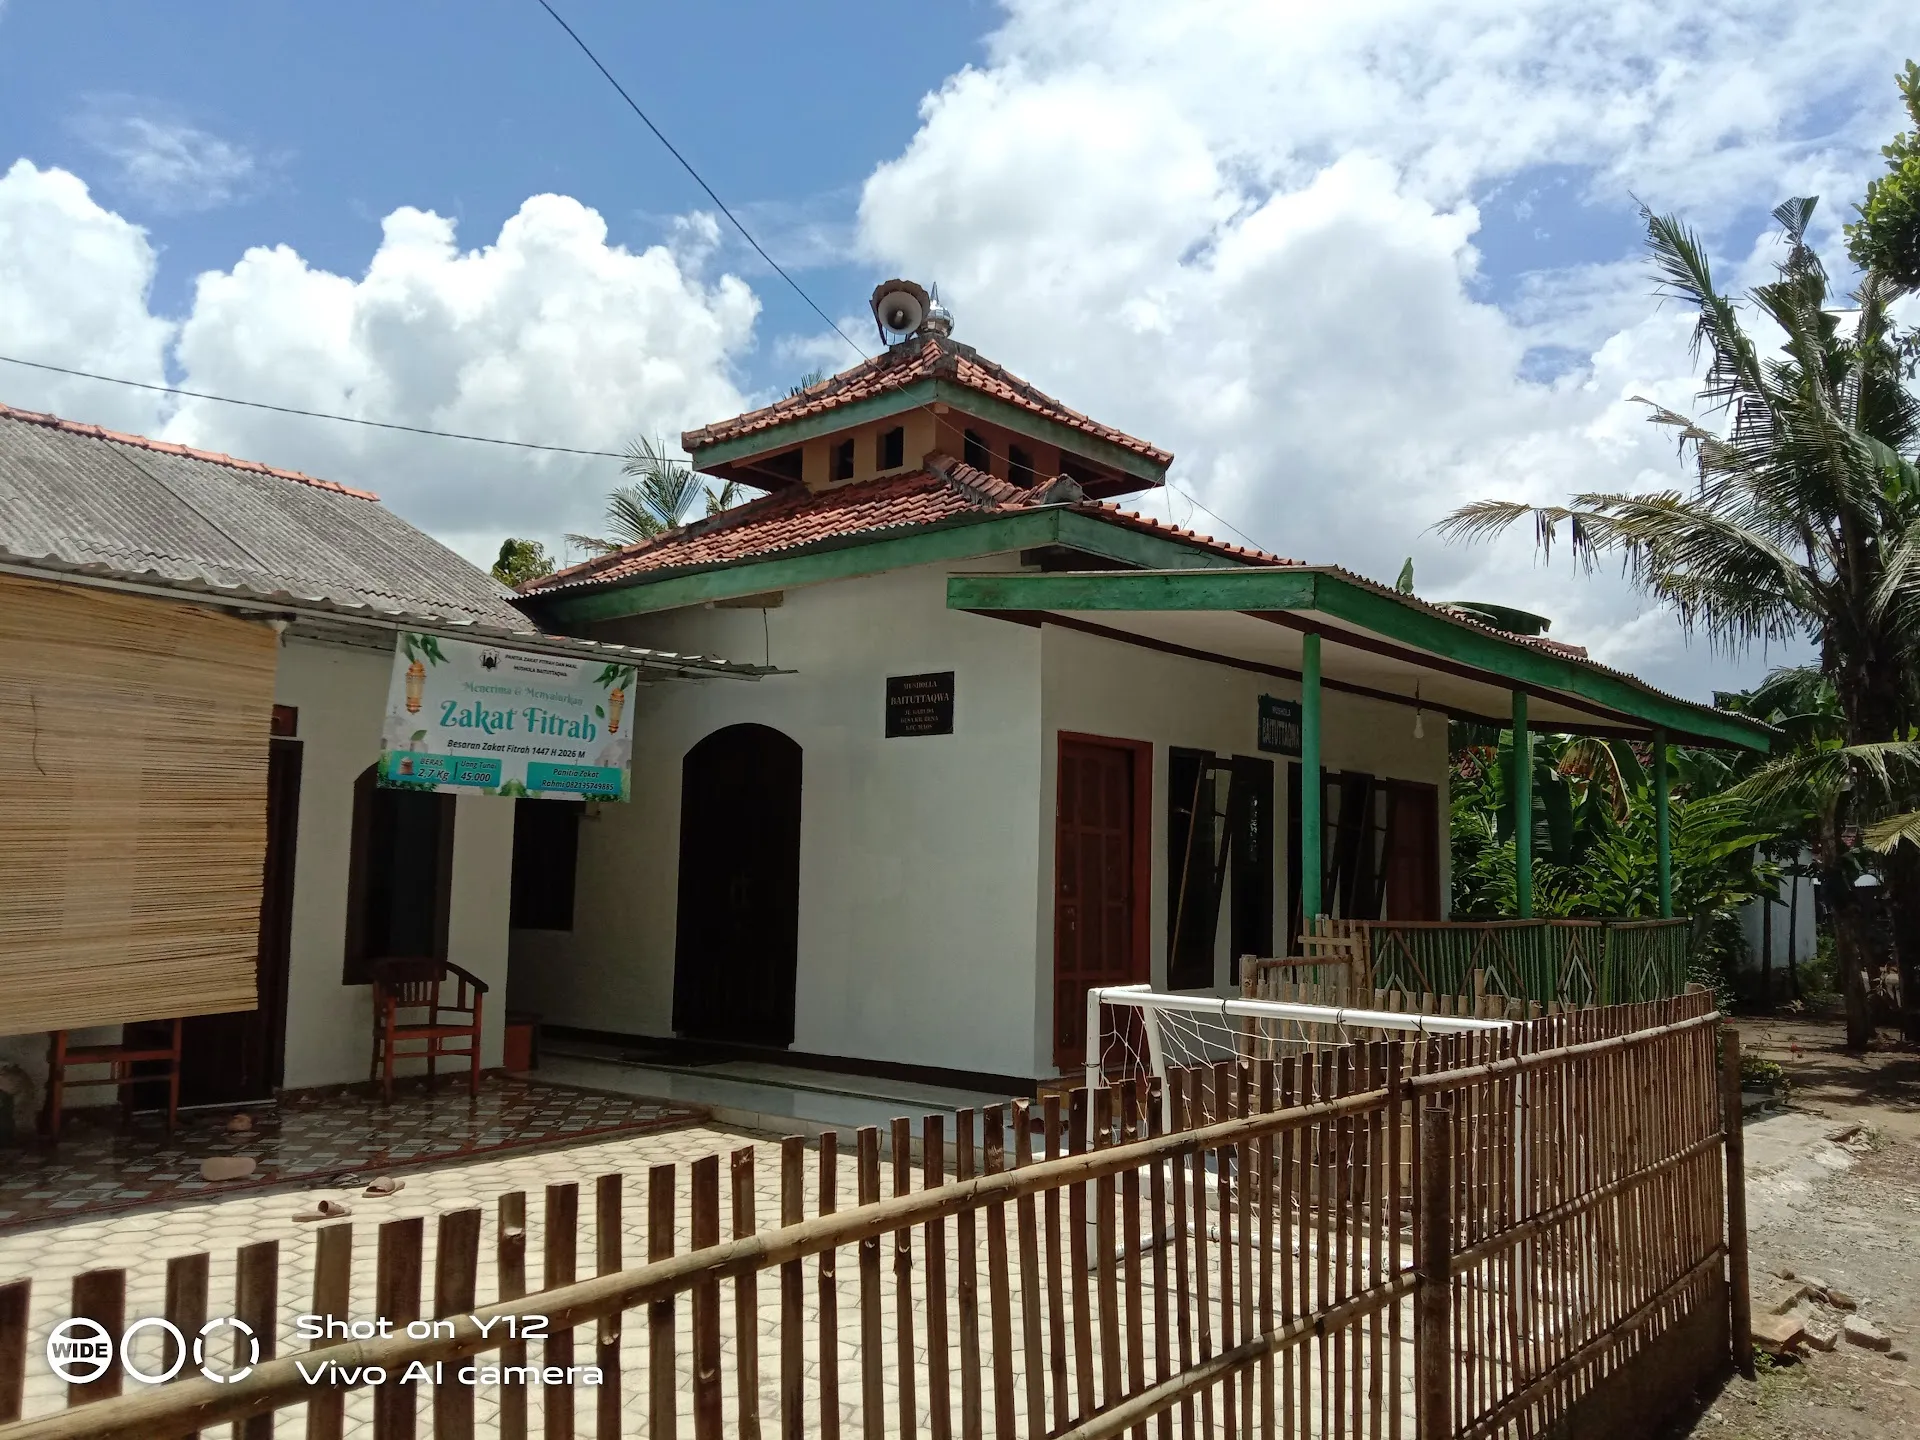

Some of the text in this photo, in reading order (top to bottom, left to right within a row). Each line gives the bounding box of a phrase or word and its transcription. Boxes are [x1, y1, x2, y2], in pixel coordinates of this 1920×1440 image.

[462, 681, 512, 695] Menerima
[524, 687, 583, 706] Menyalurkan
[890, 692, 949, 705] BAITUTTAQWA
[439, 700, 596, 743] Zakat Fitrah
[447, 739, 586, 759] Besaran Zakat Fitrah 1447 H 2026 M
[420, 758, 444, 766] BERAS
[460, 760, 478, 769] Uang
[417, 768, 450, 782] 2,7 Kg
[460, 772, 491, 781] 45.000
[553, 768, 600, 779] Panitia Zakat
